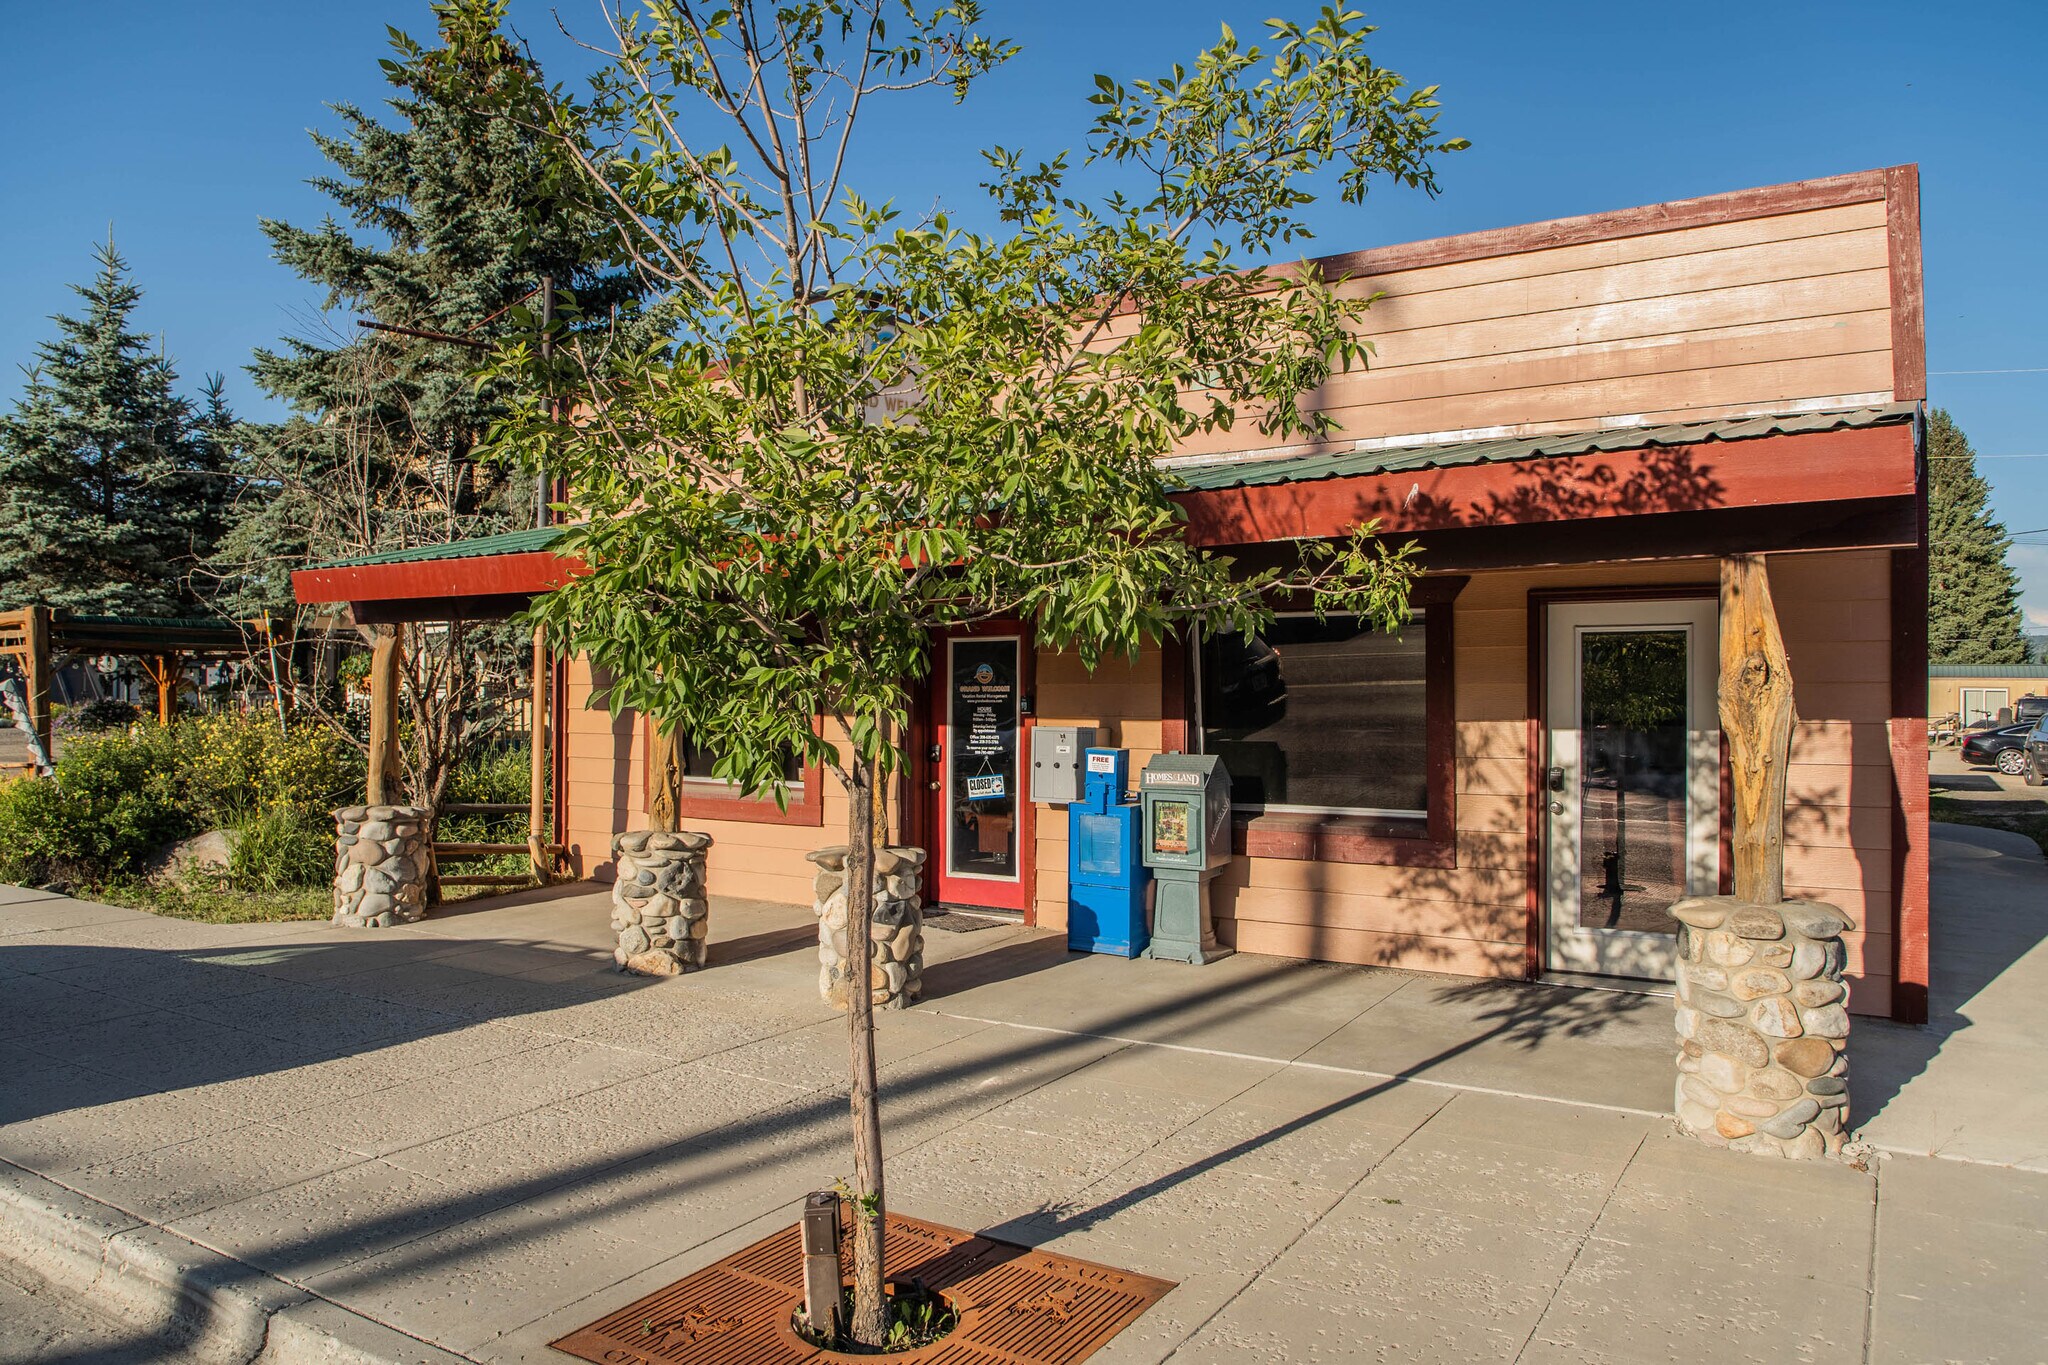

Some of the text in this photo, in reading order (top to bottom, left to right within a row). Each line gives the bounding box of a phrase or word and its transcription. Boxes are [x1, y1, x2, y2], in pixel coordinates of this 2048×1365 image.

[969, 778, 991, 790] CLOSED
[1145, 771, 1173, 784] HOMES
[1177, 773, 1200, 785] LAND
